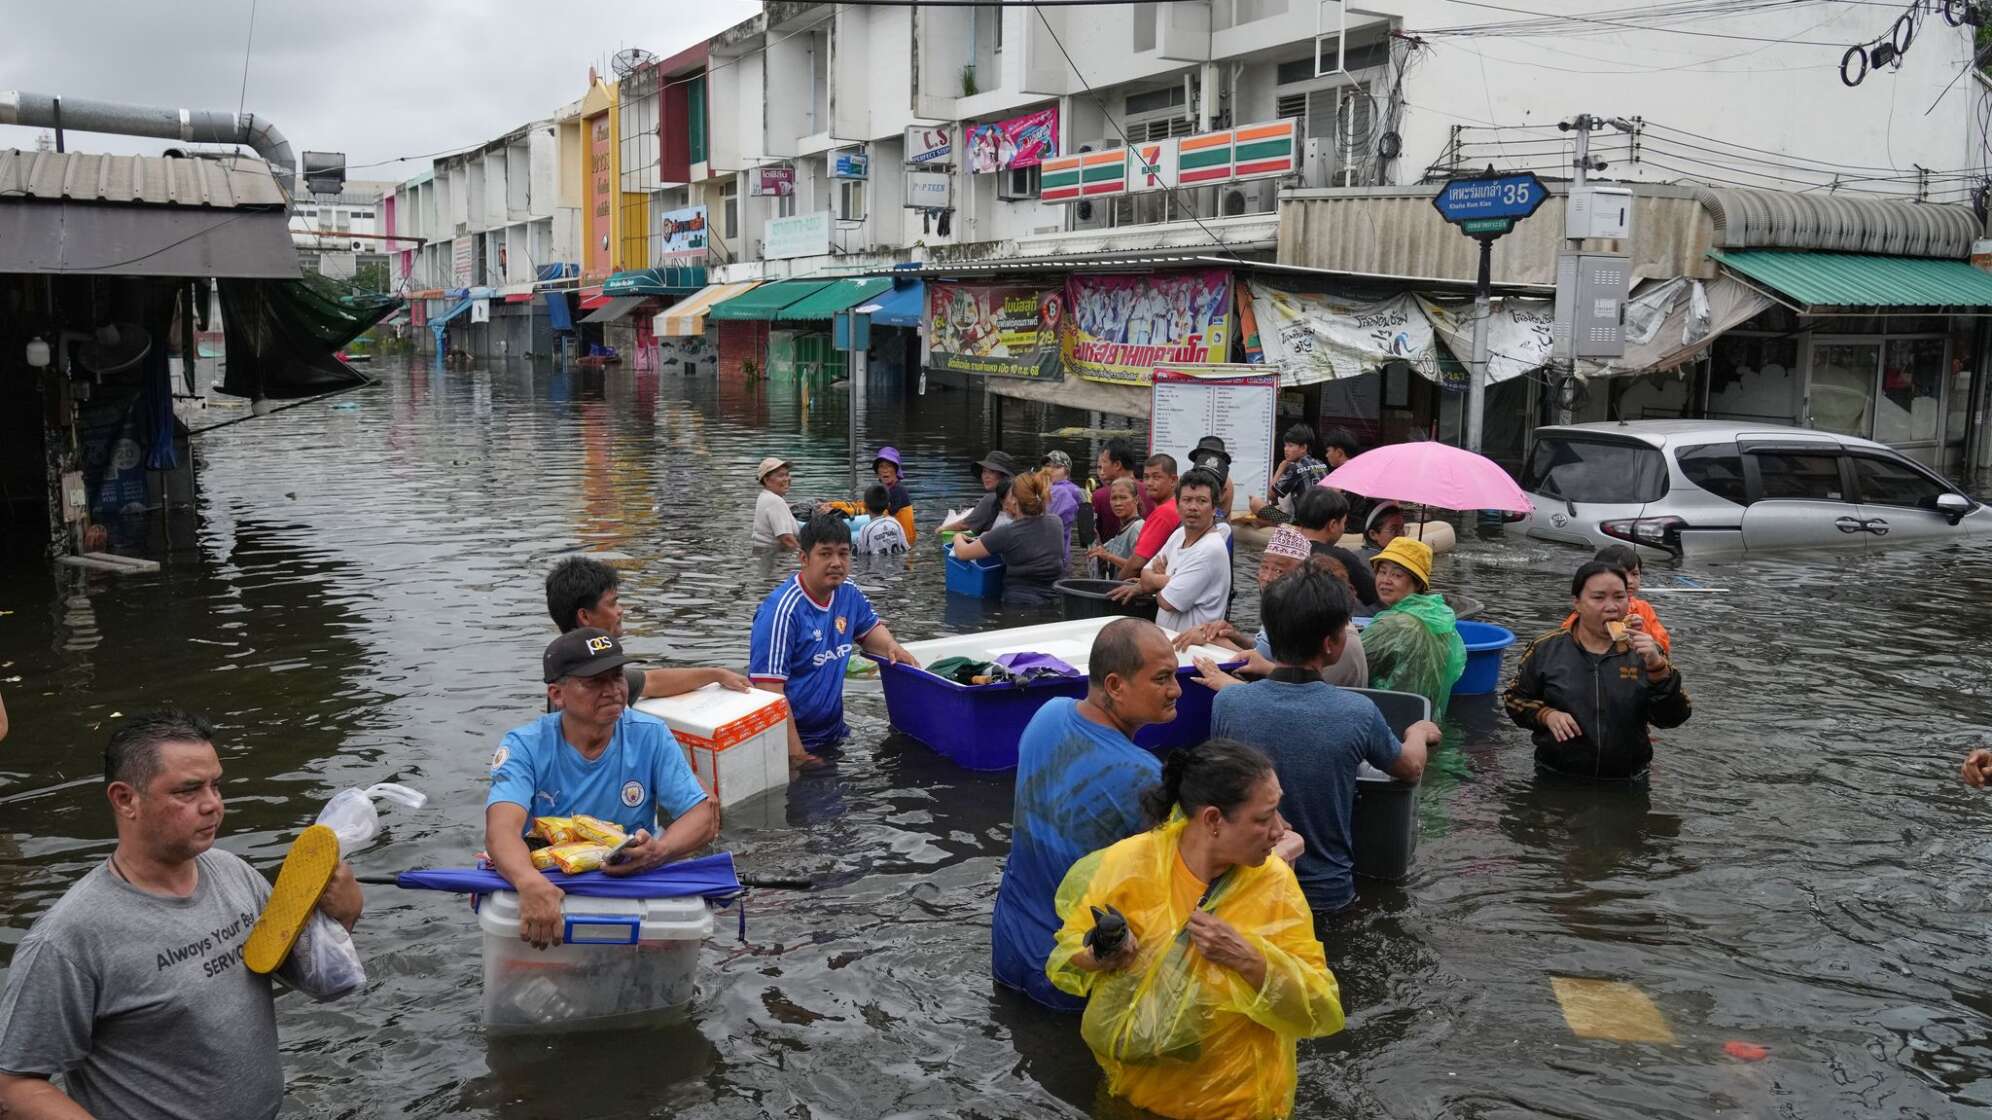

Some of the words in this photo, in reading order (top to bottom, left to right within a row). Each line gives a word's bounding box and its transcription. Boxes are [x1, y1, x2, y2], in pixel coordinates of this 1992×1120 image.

[1142, 146, 1161, 187] 7
[1503, 182, 1530, 205] 35
[156, 937, 212, 972] Always
[211, 920, 241, 944] Your
[202, 943, 244, 978] SERVIC
